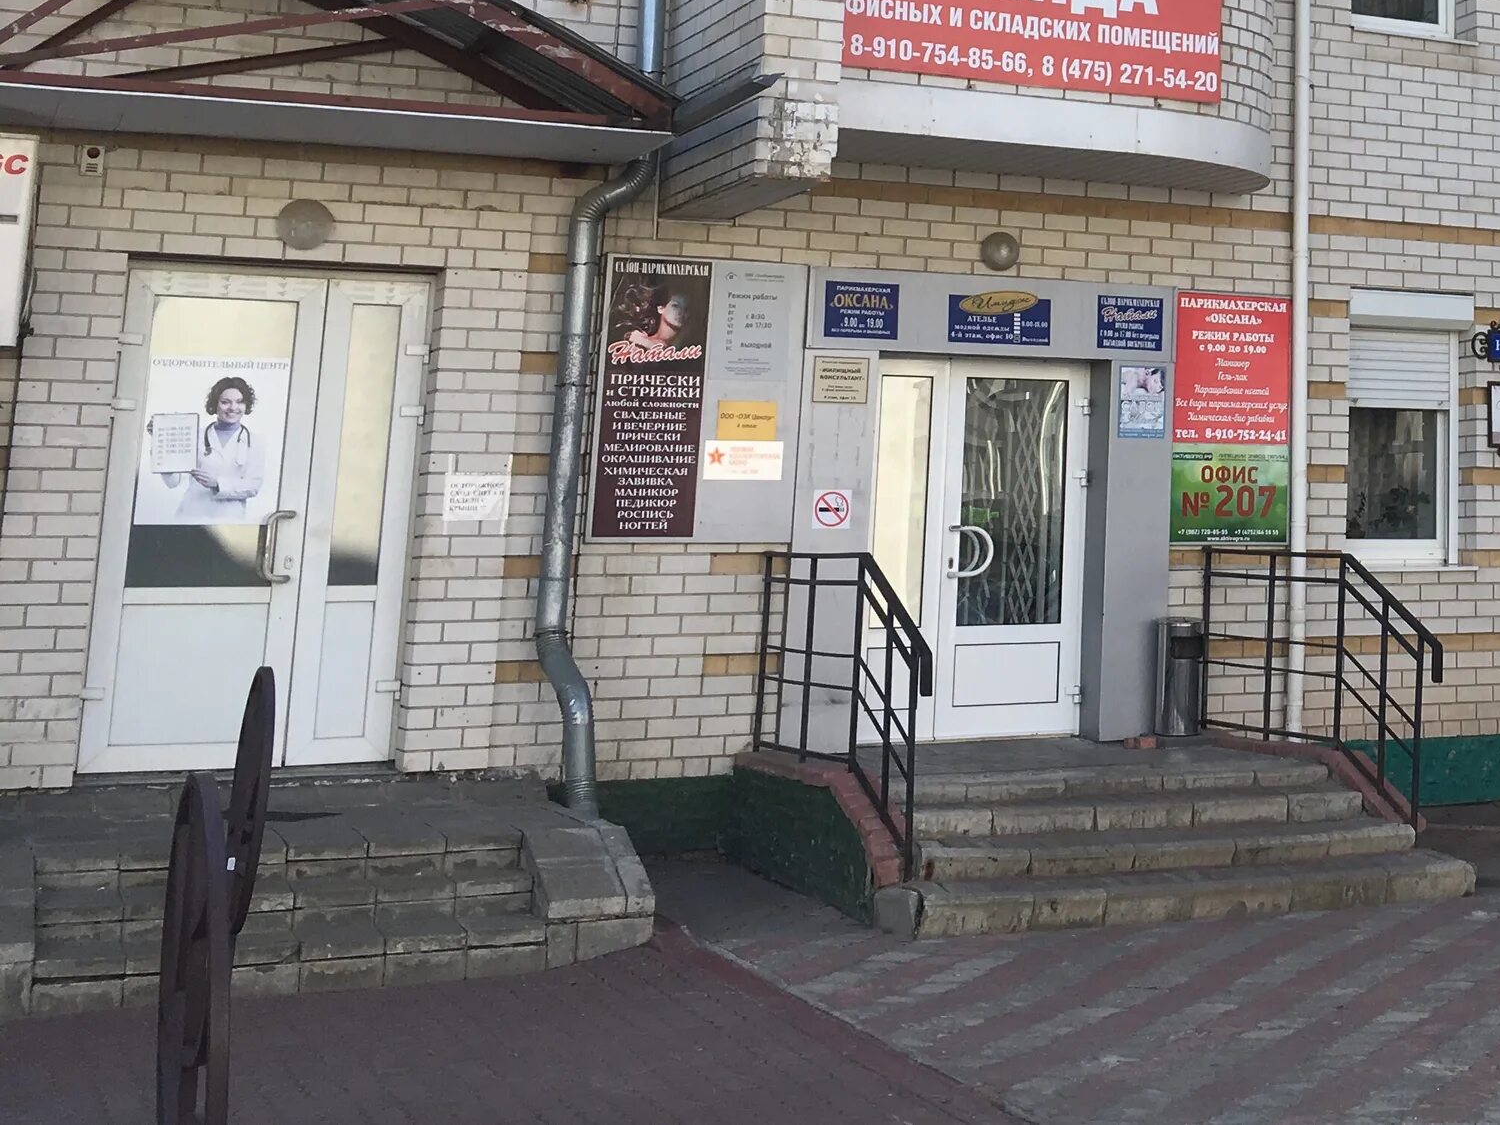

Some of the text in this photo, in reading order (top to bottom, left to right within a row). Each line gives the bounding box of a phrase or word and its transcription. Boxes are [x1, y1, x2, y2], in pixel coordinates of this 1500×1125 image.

[949, 6, 962, 27] И
[969, 8, 1091, 43] СКЛАДСКИХ
[1097, 22, 1219, 55] ПОМЕЩЕНИЙ
[850, 34, 1218, 92] 8-910-754-85-66, 8 (475) 271-54-20
[836, 285, 891, 293] ПАРИКМАХЕРСКАЯ
[1180, 297, 1287, 313] ПАРИКМАХЕРСКАЯ
[866, 318, 883, 328] 19.00
[967, 315, 997, 323] АТЕЛЬЕ
[1205, 313, 1263, 325] «ОКСАНА»
[1192, 330, 1275, 343] РЕЖИМ РАБОТЫ
[608, 340, 702, 365] Натали
[1207, 343, 1226, 353] 9.00
[1228, 345, 1241, 353] до
[1243, 344, 1267, 354] 19.00
[153, 358, 289, 371] ОЗДОРОВИТЕЛЬНЫЙ ЦЕНТР
[610, 374, 701, 386] ПРИЧЕСКИ
[617, 386, 700, 398] СТРИЖКИ
[604, 398, 639, 407] любой
[613, 410, 687, 420] СВАДЕБНЫЕ
[612, 422, 687, 431] И ВЕЧЕРНИЕ
[616, 432, 681, 441] ПРИЧЕСКИ
[1175, 428, 1198, 438] тел.
[1205, 427, 1287, 441] 8-910-752-24-41
[603, 443, 696, 453] МЕЛИРОВАНИЕ
[601, 455, 696, 464] ОКРАШИВАНИЕ
[603, 467, 688, 476] ХИМИЧЕСКАЯ
[1200, 464, 1259, 484] ОФИС
[617, 477, 674, 486] ЗАВИВКА
[614, 488, 679, 496] МАНИКЮР
[615, 499, 677, 508] ПЕДИКЮР
[1182, 484, 1277, 518] № 207
[617, 510, 674, 519] РОСПИСЬ
[619, 519, 668, 530] НОГТЕЙ
